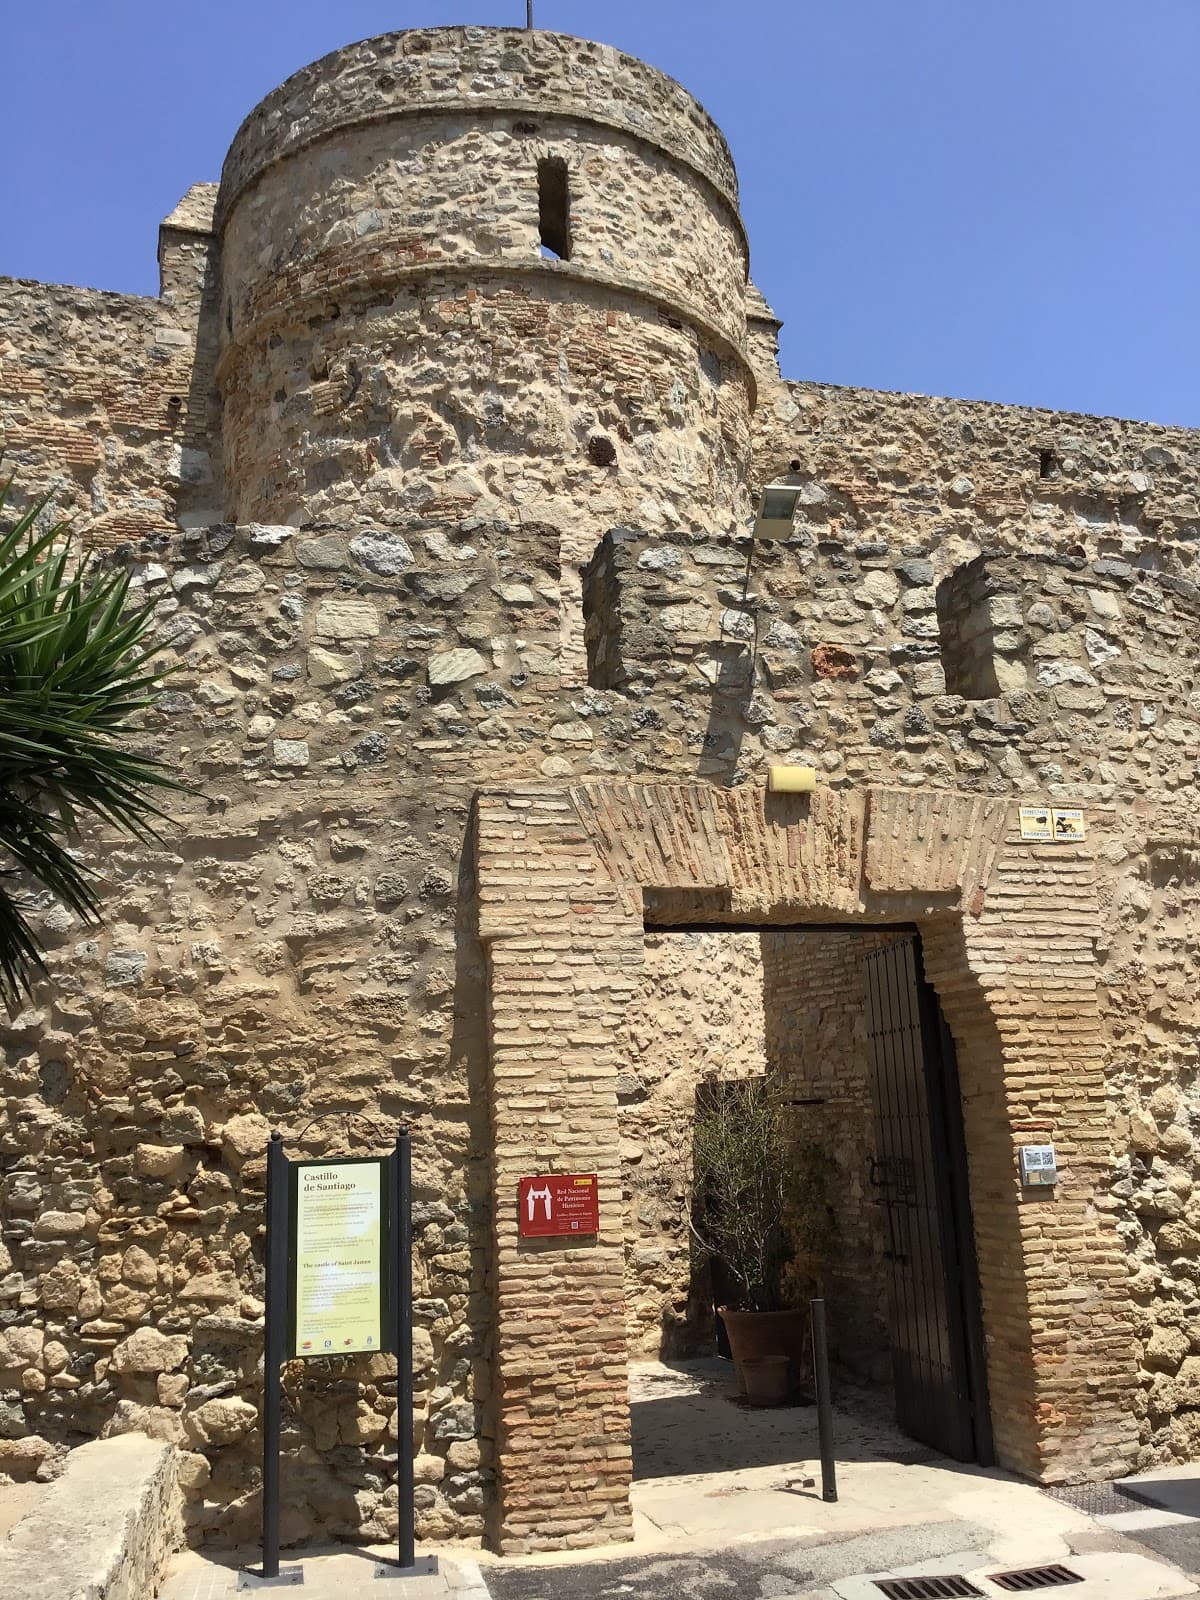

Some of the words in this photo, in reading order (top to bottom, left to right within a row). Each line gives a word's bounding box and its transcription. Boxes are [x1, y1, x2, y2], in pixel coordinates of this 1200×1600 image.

[303, 1172, 338, 1181] Castillo
[303, 1184, 315, 1192] de
[316, 1182, 356, 1191] Santiago
